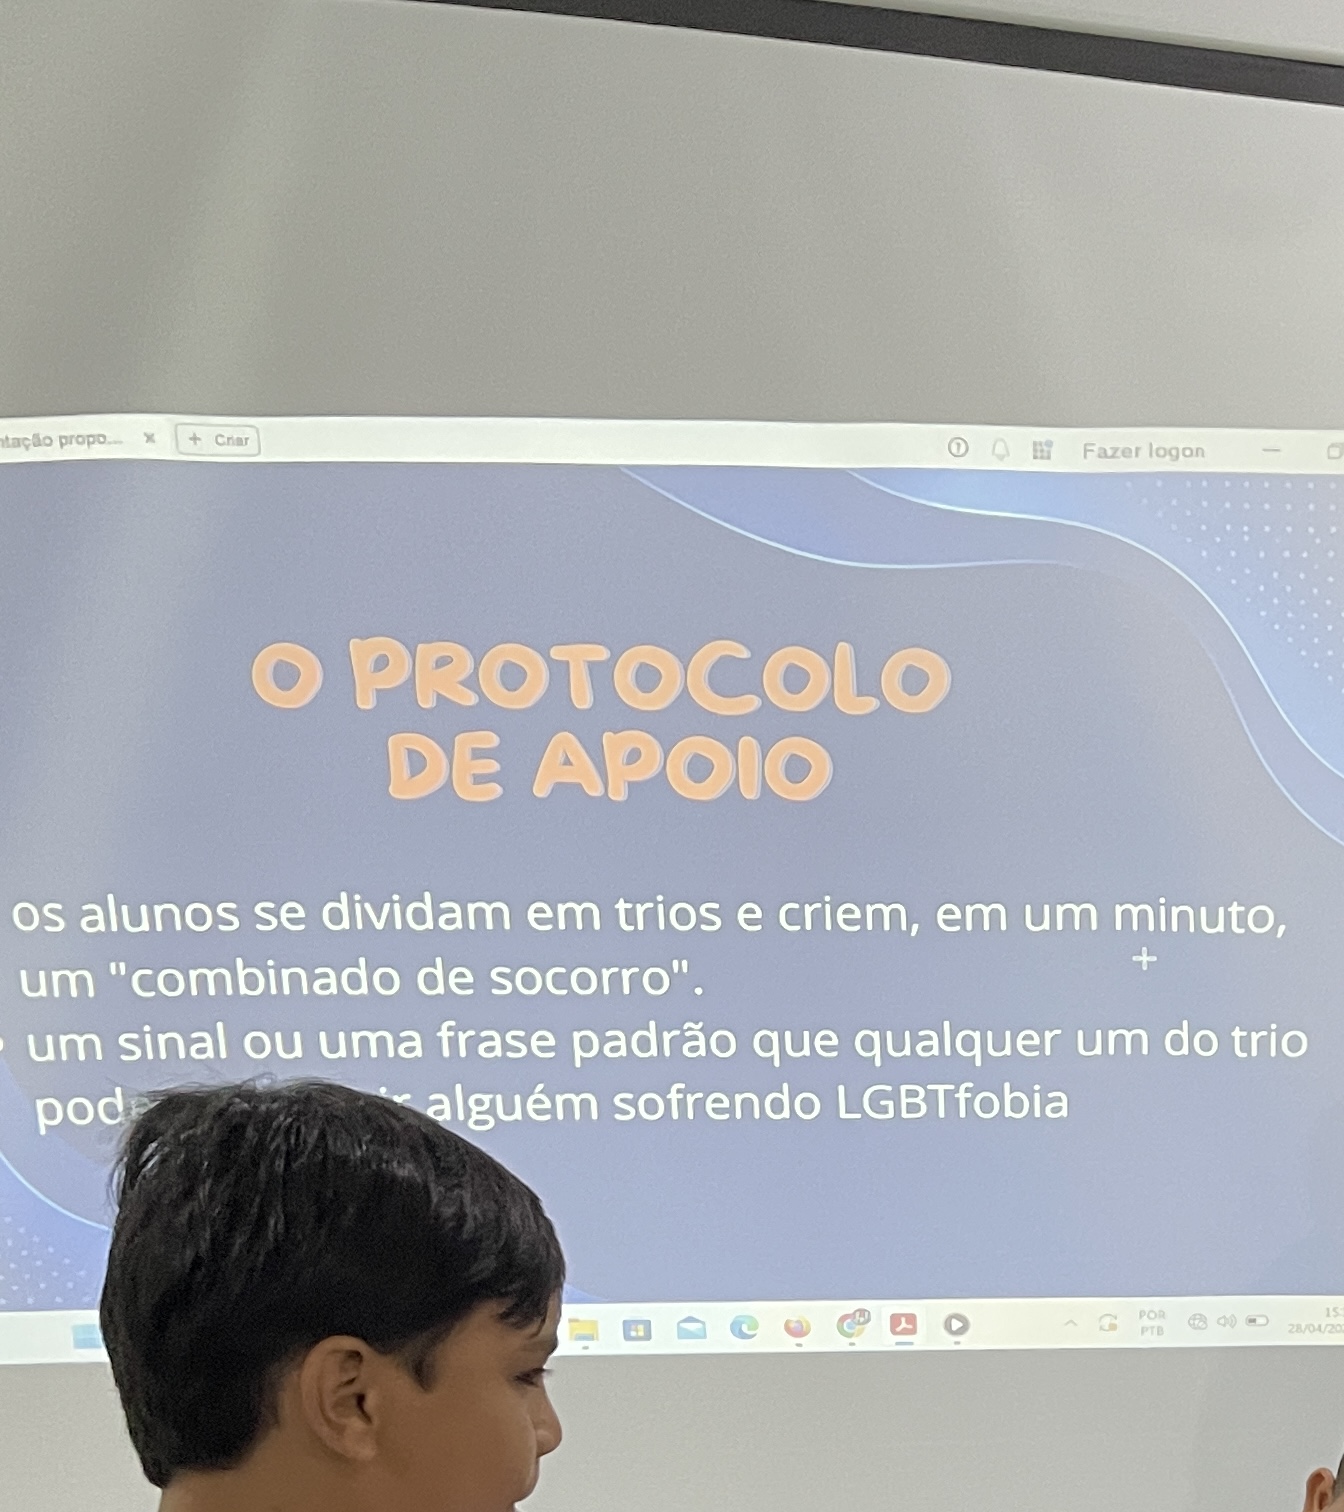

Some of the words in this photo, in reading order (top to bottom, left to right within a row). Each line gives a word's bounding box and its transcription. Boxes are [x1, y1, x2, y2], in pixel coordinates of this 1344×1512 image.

[214, 433, 250, 447] Criar
[1083, 443, 1141, 460] Fazer
[1148, 442, 1206, 462] logon
[251, 642, 321, 710] O
[348, 636, 949, 717] PROTOCOLO
[387, 730, 501, 803] DE
[532, 729, 830, 802] APOIO
[12, 902, 66, 933] os
[80, 893, 240, 933] alunos
[254, 901, 306, 931] se
[322, 891, 511, 931] dividam
[527, 901, 601, 931] em
[614, 894, 722, 932] trios
[737, 902, 763, 932] e
[779, 895, 919, 937] criem,
[936, 903, 1007, 932] em
[1025, 903, 1098, 932] um
[1114, 896, 1287, 939] minuto,
[19, 969, 95, 998] um
[109, 956, 401, 998] "combinado
[417, 956, 474, 996] de
[490, 959, 703, 996] socorro".
[27, 1033, 103, 1062] um
[118, 1021, 227, 1061] sinal
[243, 1031, 303, 1060] ou
[319, 1030, 423, 1059] uma
[436, 1020, 556, 1059] frase
[572, 1020, 737, 1068] padrão
[753, 1029, 839, 1068] que
[854, 1020, 1062, 1067] qualquer
[1077, 1028, 1149, 1057] um
[1164, 1019, 1219, 1057] do
[1230, 1023, 1308, 1058] trio
[426, 1083, 598, 1131] alguém
[613, 1082, 821, 1121] sofrendo
[837, 1081, 1068, 1120] LGBTfobia
[1138, 1309, 1166, 1321] POR
